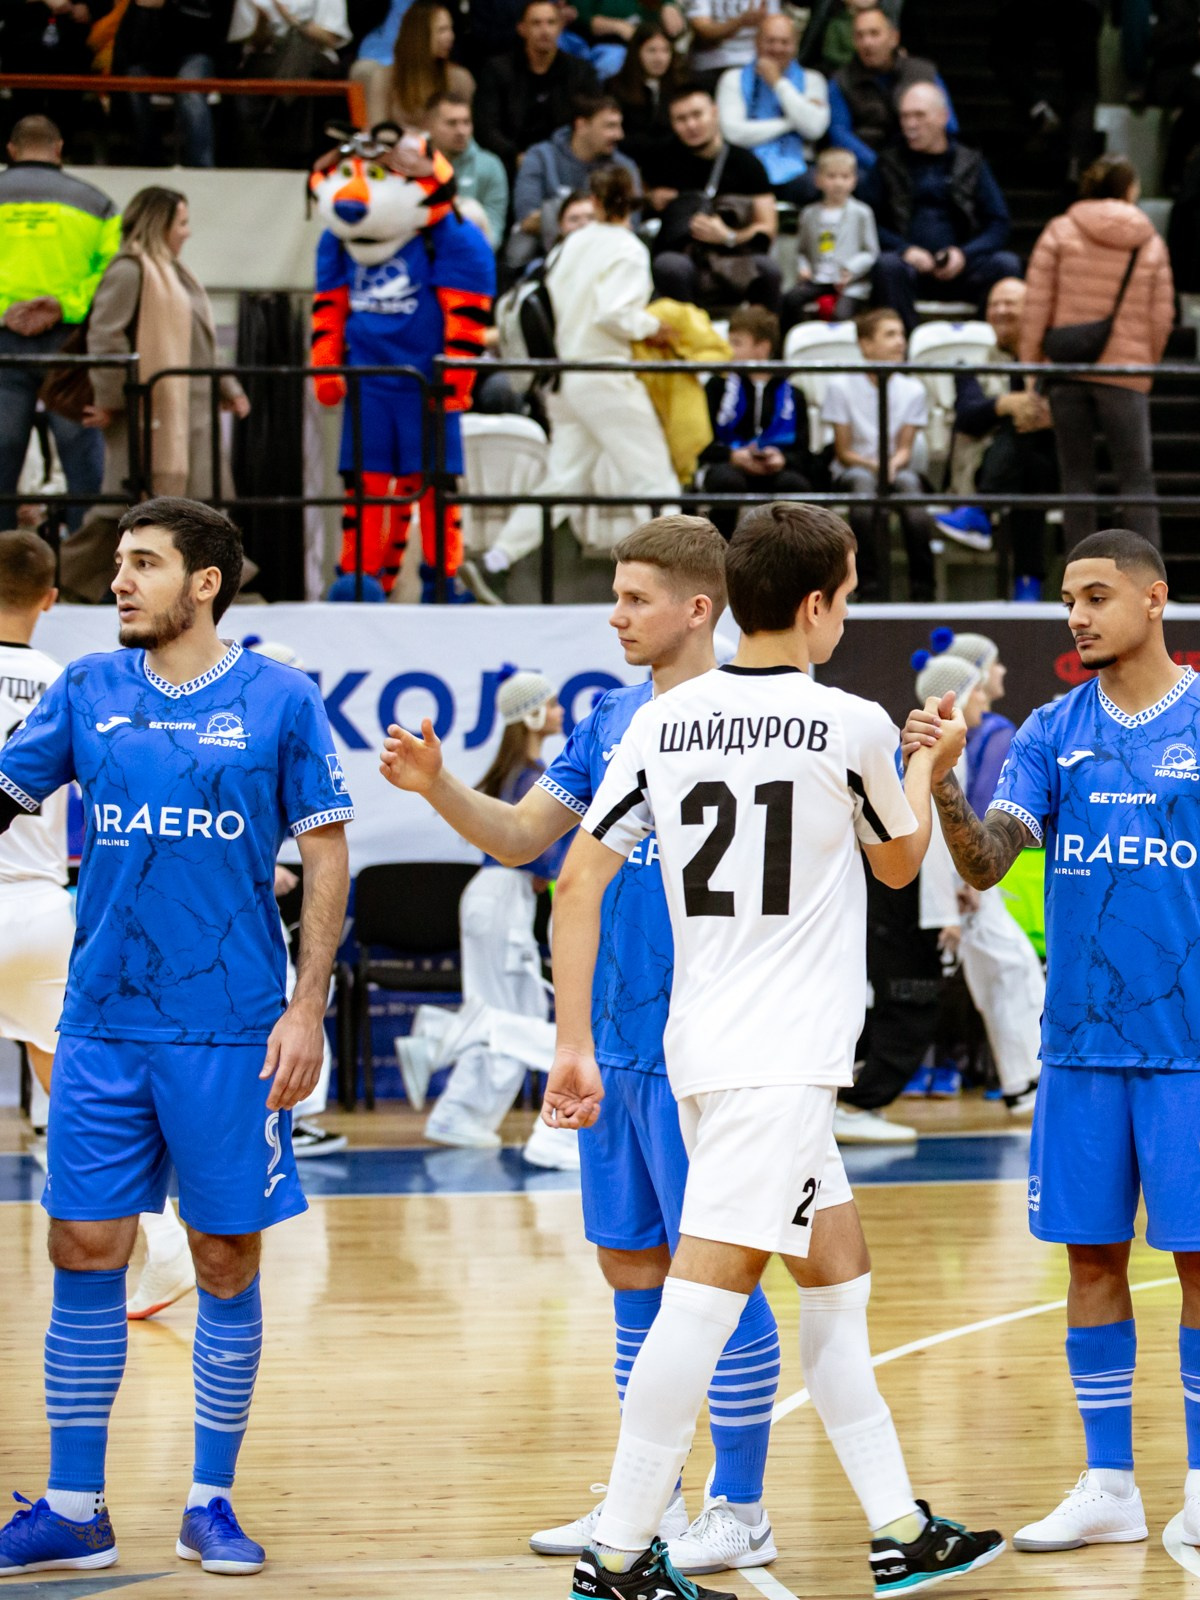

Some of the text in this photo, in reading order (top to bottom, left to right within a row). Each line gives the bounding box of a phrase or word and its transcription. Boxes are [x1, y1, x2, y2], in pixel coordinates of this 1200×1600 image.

[149, 722, 196, 730] БЕТСИТИ
[659, 711, 829, 756] ШАЙДУРОВ
[199, 737, 246, 750] ИРАЭРО
[1154, 769, 1200, 781] ИРАЭРО
[1089, 792, 1157, 804] БЕТСИТИ
[94, 802, 245, 840] IRAERO
[681, 780, 794, 917] 21
[1055, 833, 1198, 869] IRAERO
[1054, 868, 1091, 876] AIRLINES
[791, 1177, 821, 1227] 2
